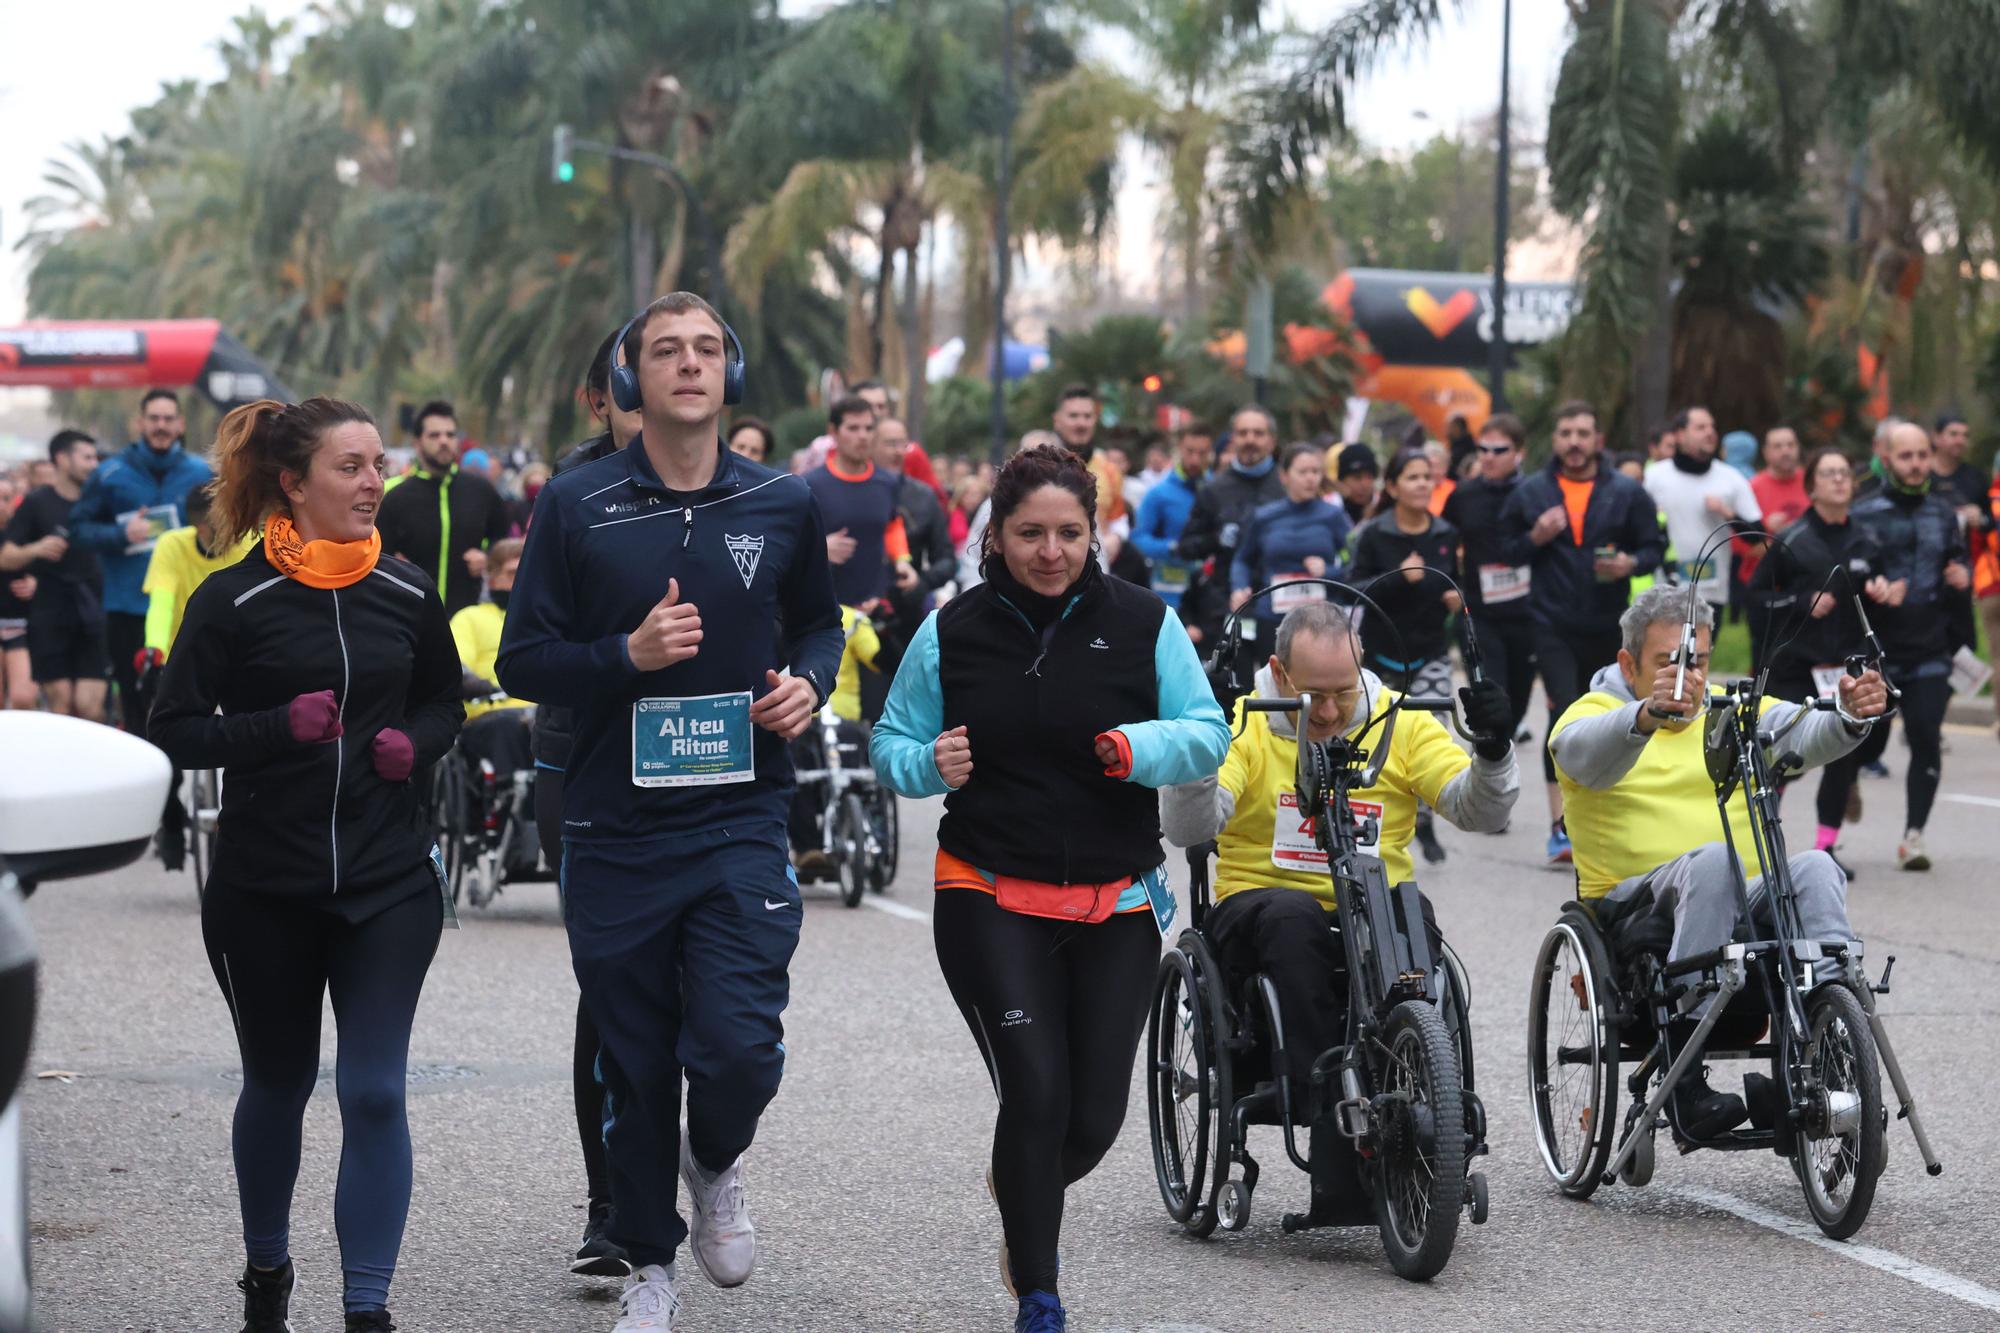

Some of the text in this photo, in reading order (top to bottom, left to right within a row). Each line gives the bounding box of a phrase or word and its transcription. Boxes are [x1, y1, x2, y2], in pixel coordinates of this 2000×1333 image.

[659, 717, 724, 736] Al teu
[672, 738, 729, 756] Ritme
